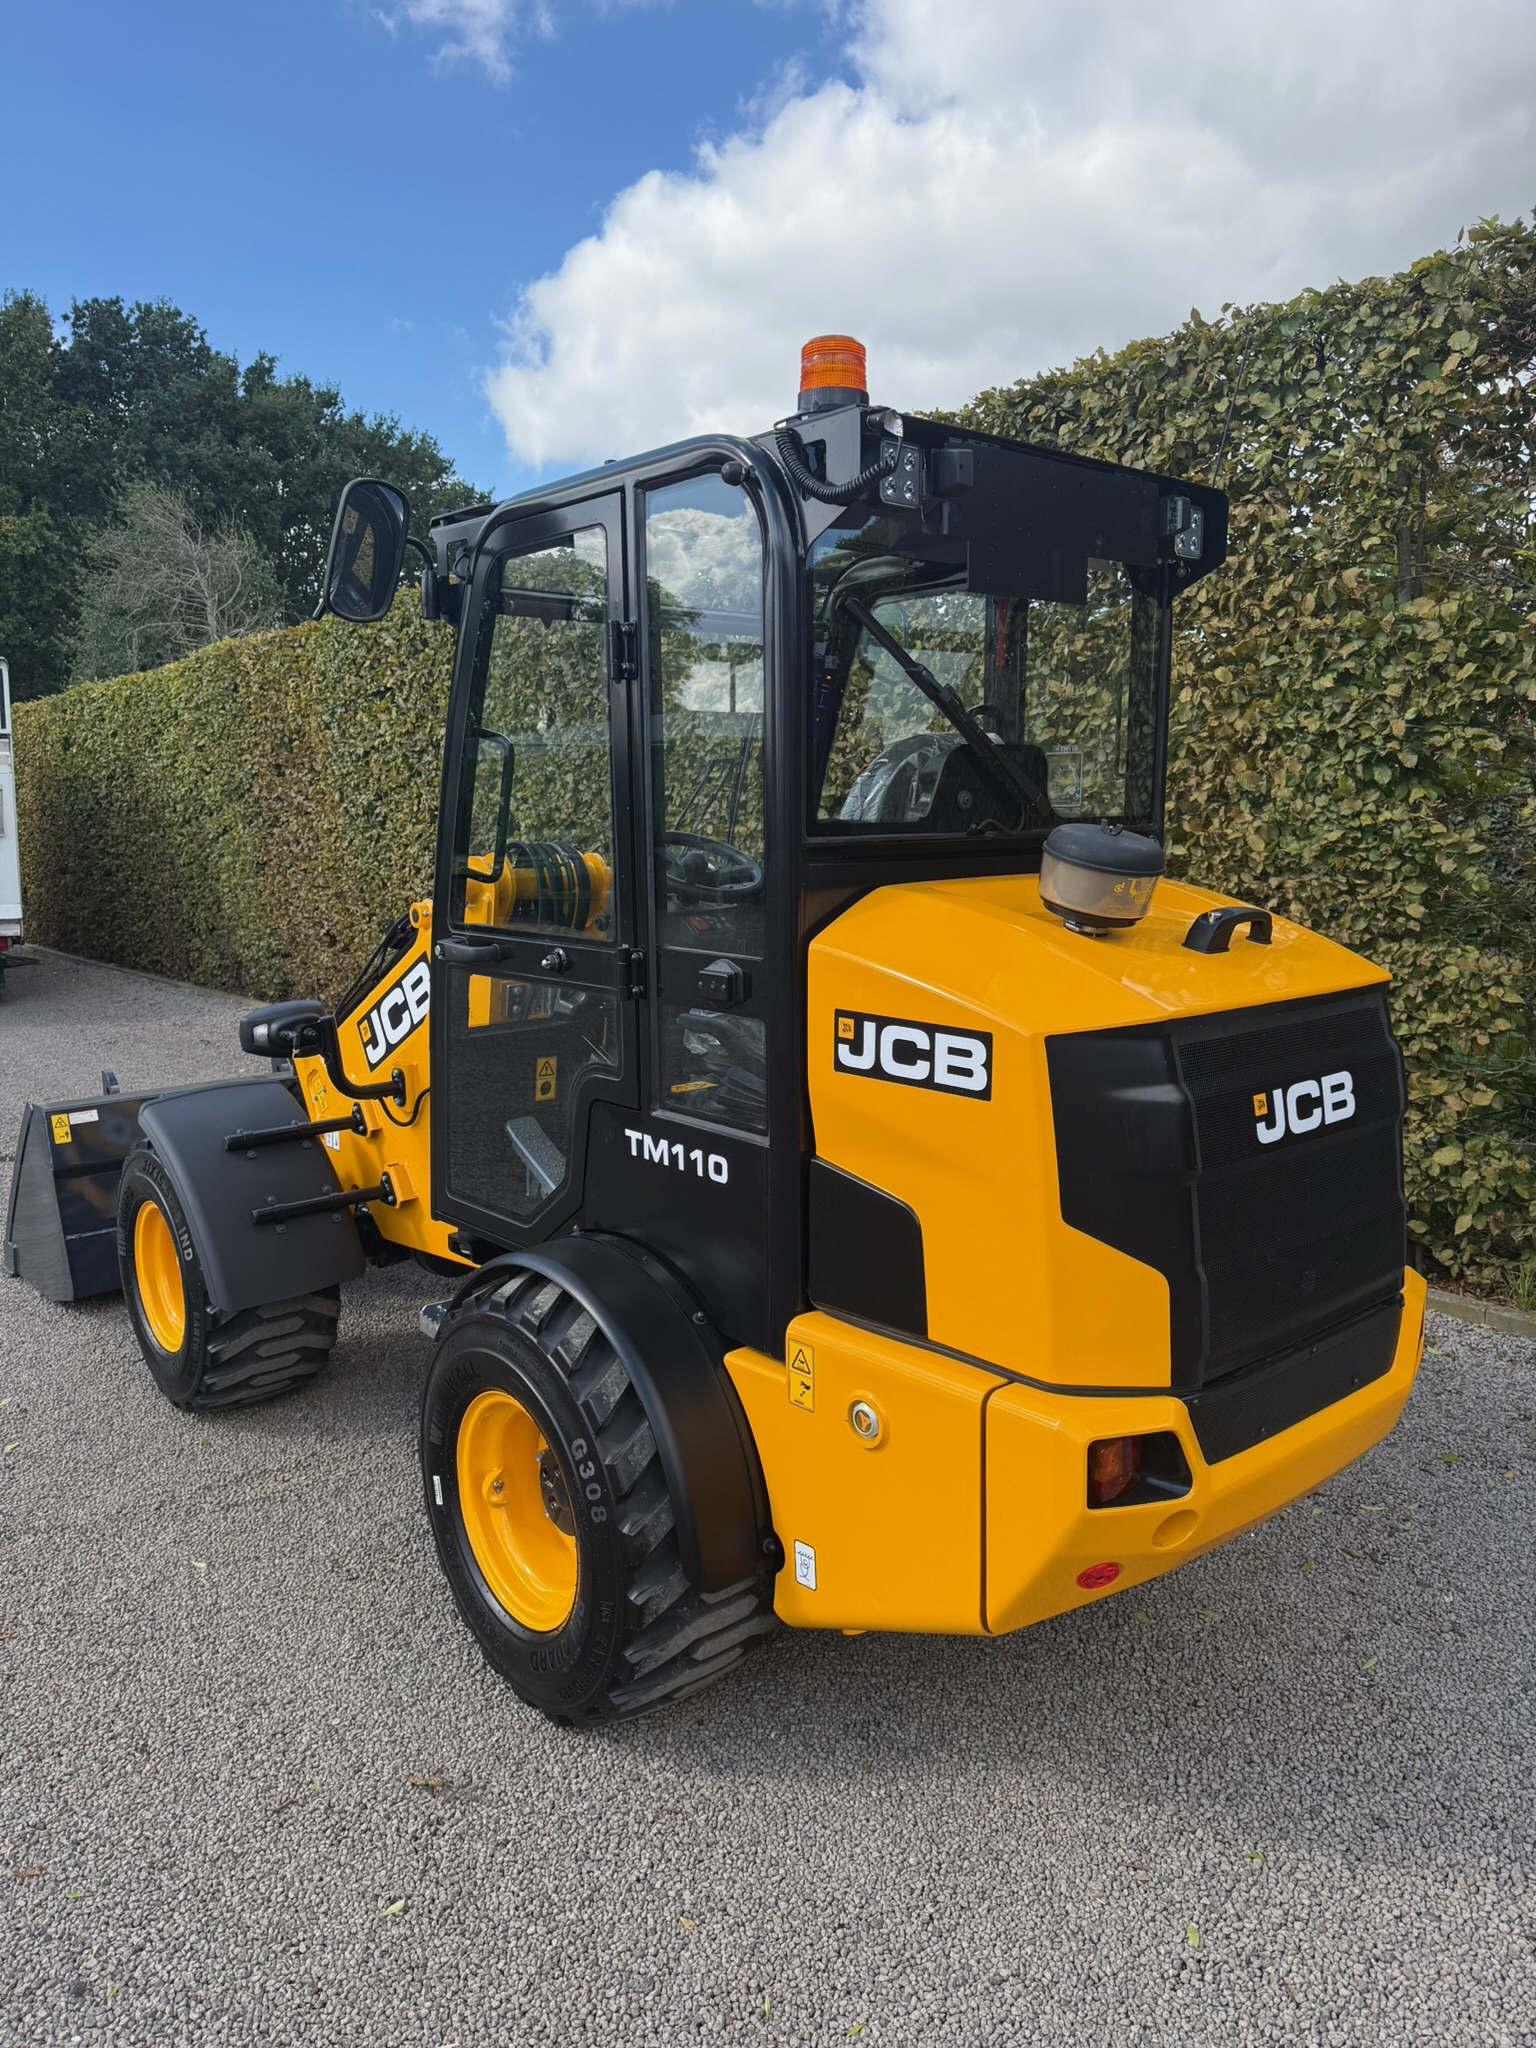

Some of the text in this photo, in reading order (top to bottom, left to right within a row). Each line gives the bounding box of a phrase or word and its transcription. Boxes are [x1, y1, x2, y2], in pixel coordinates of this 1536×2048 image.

[366, 962, 430, 1064] JCB
[838, 1021, 988, 1091] JCB
[1256, 1071, 1356, 1144] JCB
[625, 1128, 728, 1184] TM110
[178, 1226, 193, 1261] IND
[444, 1361, 482, 1395] WALL
[571, 1438, 607, 1523] G308
